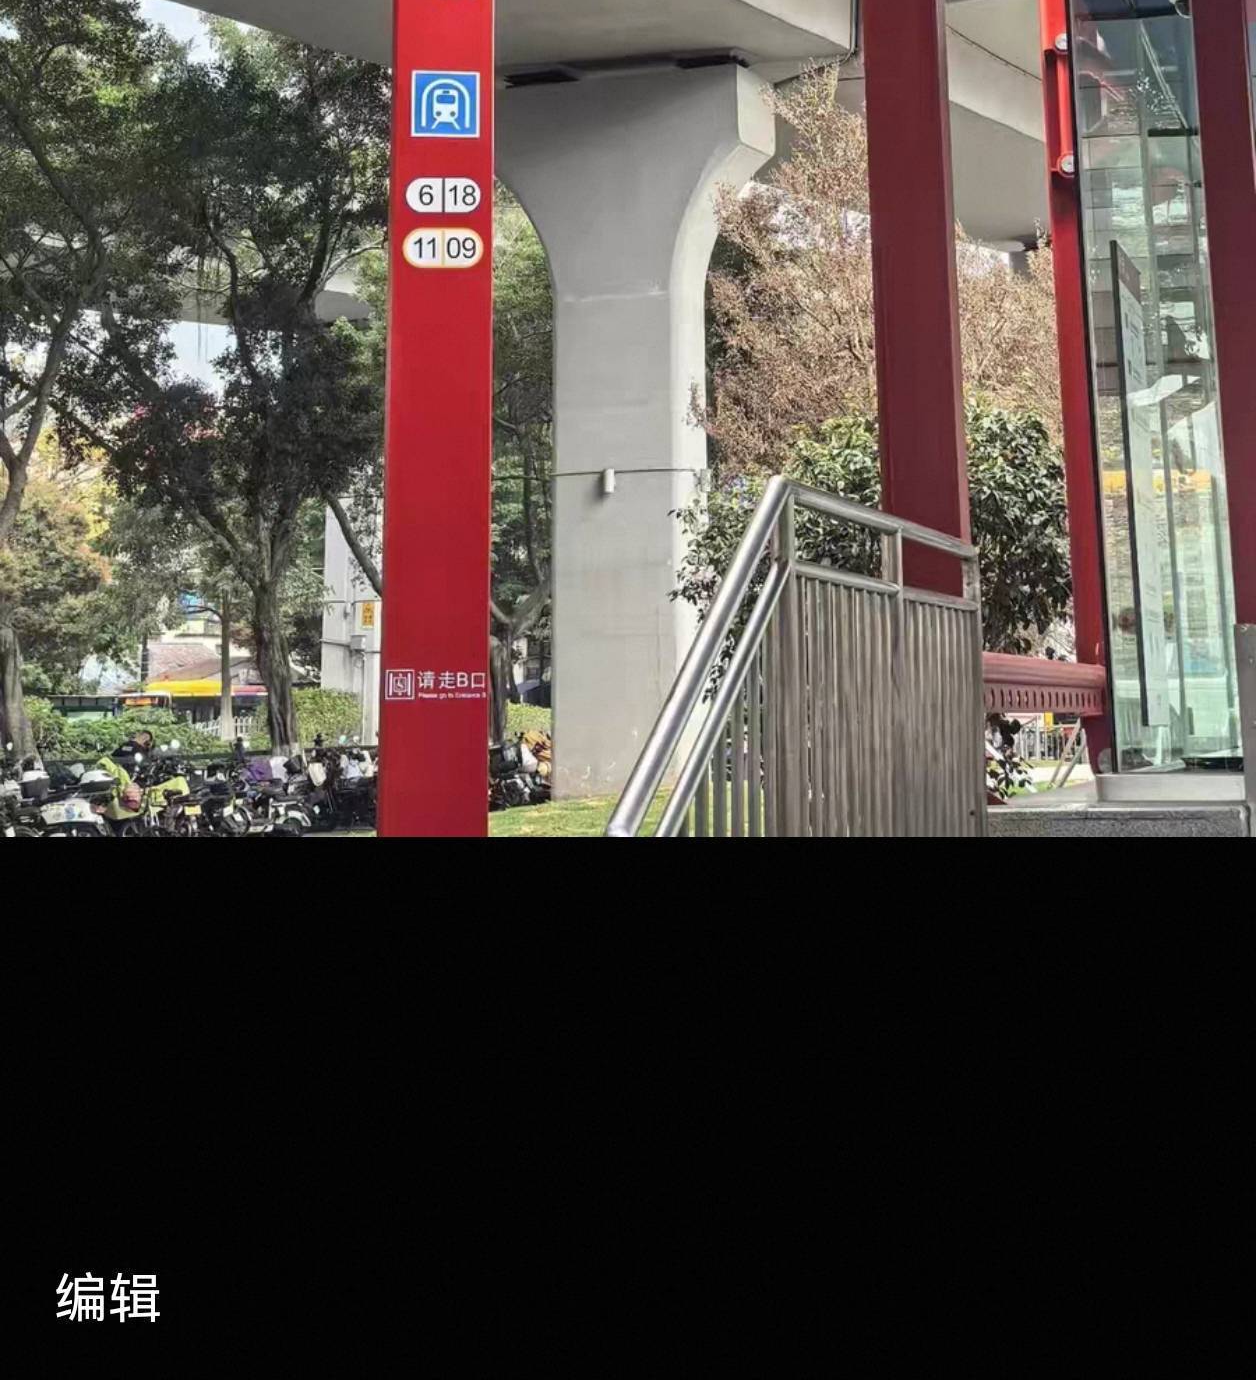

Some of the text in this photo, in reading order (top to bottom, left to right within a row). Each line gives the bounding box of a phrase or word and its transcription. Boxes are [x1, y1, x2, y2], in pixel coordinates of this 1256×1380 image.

[418, 184, 477, 207] 6 18
[413, 237, 477, 260] 11 09
[416, 670, 486, 689] 请走B口
